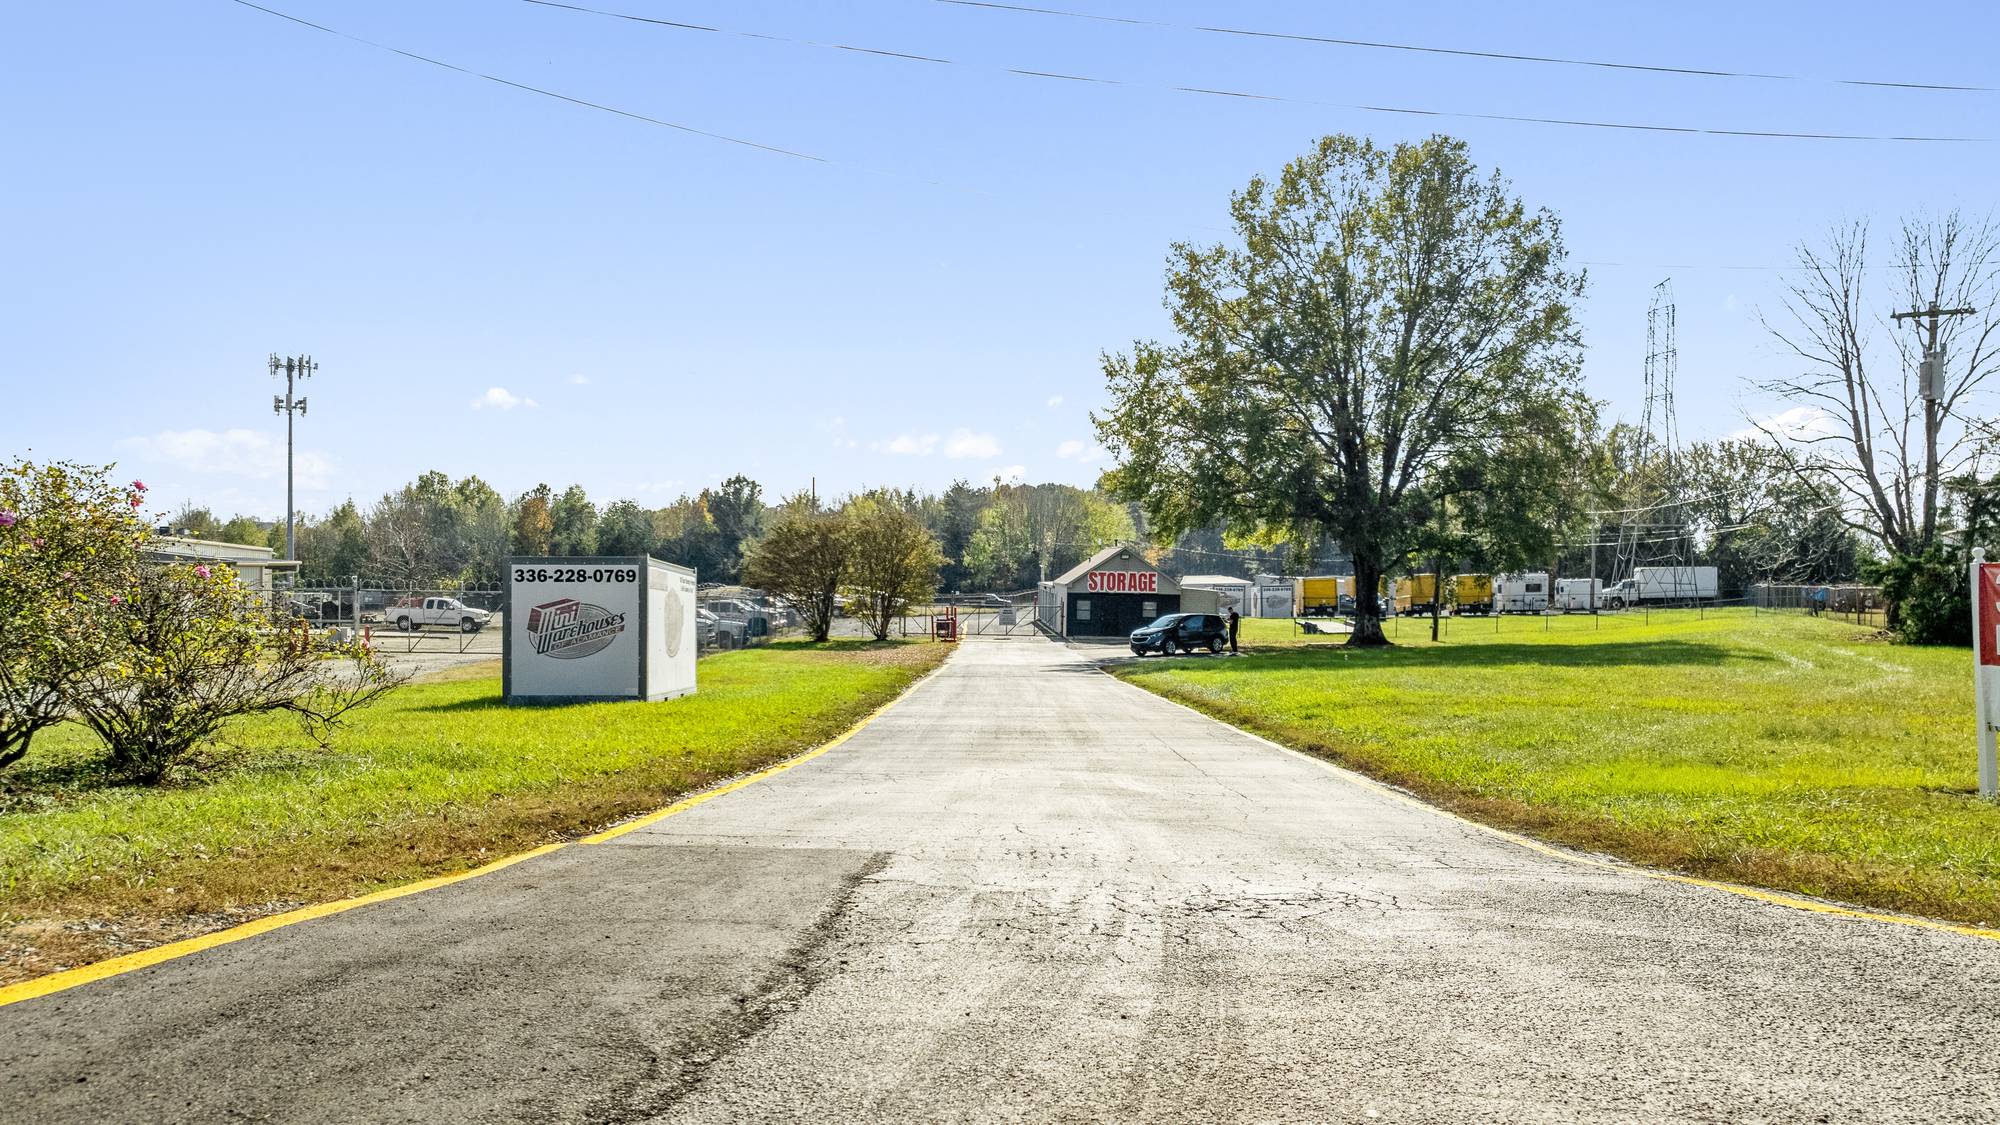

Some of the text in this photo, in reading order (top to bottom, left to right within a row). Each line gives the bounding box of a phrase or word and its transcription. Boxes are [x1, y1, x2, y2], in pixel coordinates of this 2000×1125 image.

[514, 569, 636, 583] 336-228-0769
[1088, 571, 1157, 593] STORAGE
[538, 606, 577, 634] Mini
[537, 612, 626, 654] Warehouses
[552, 640, 569, 650] OF
